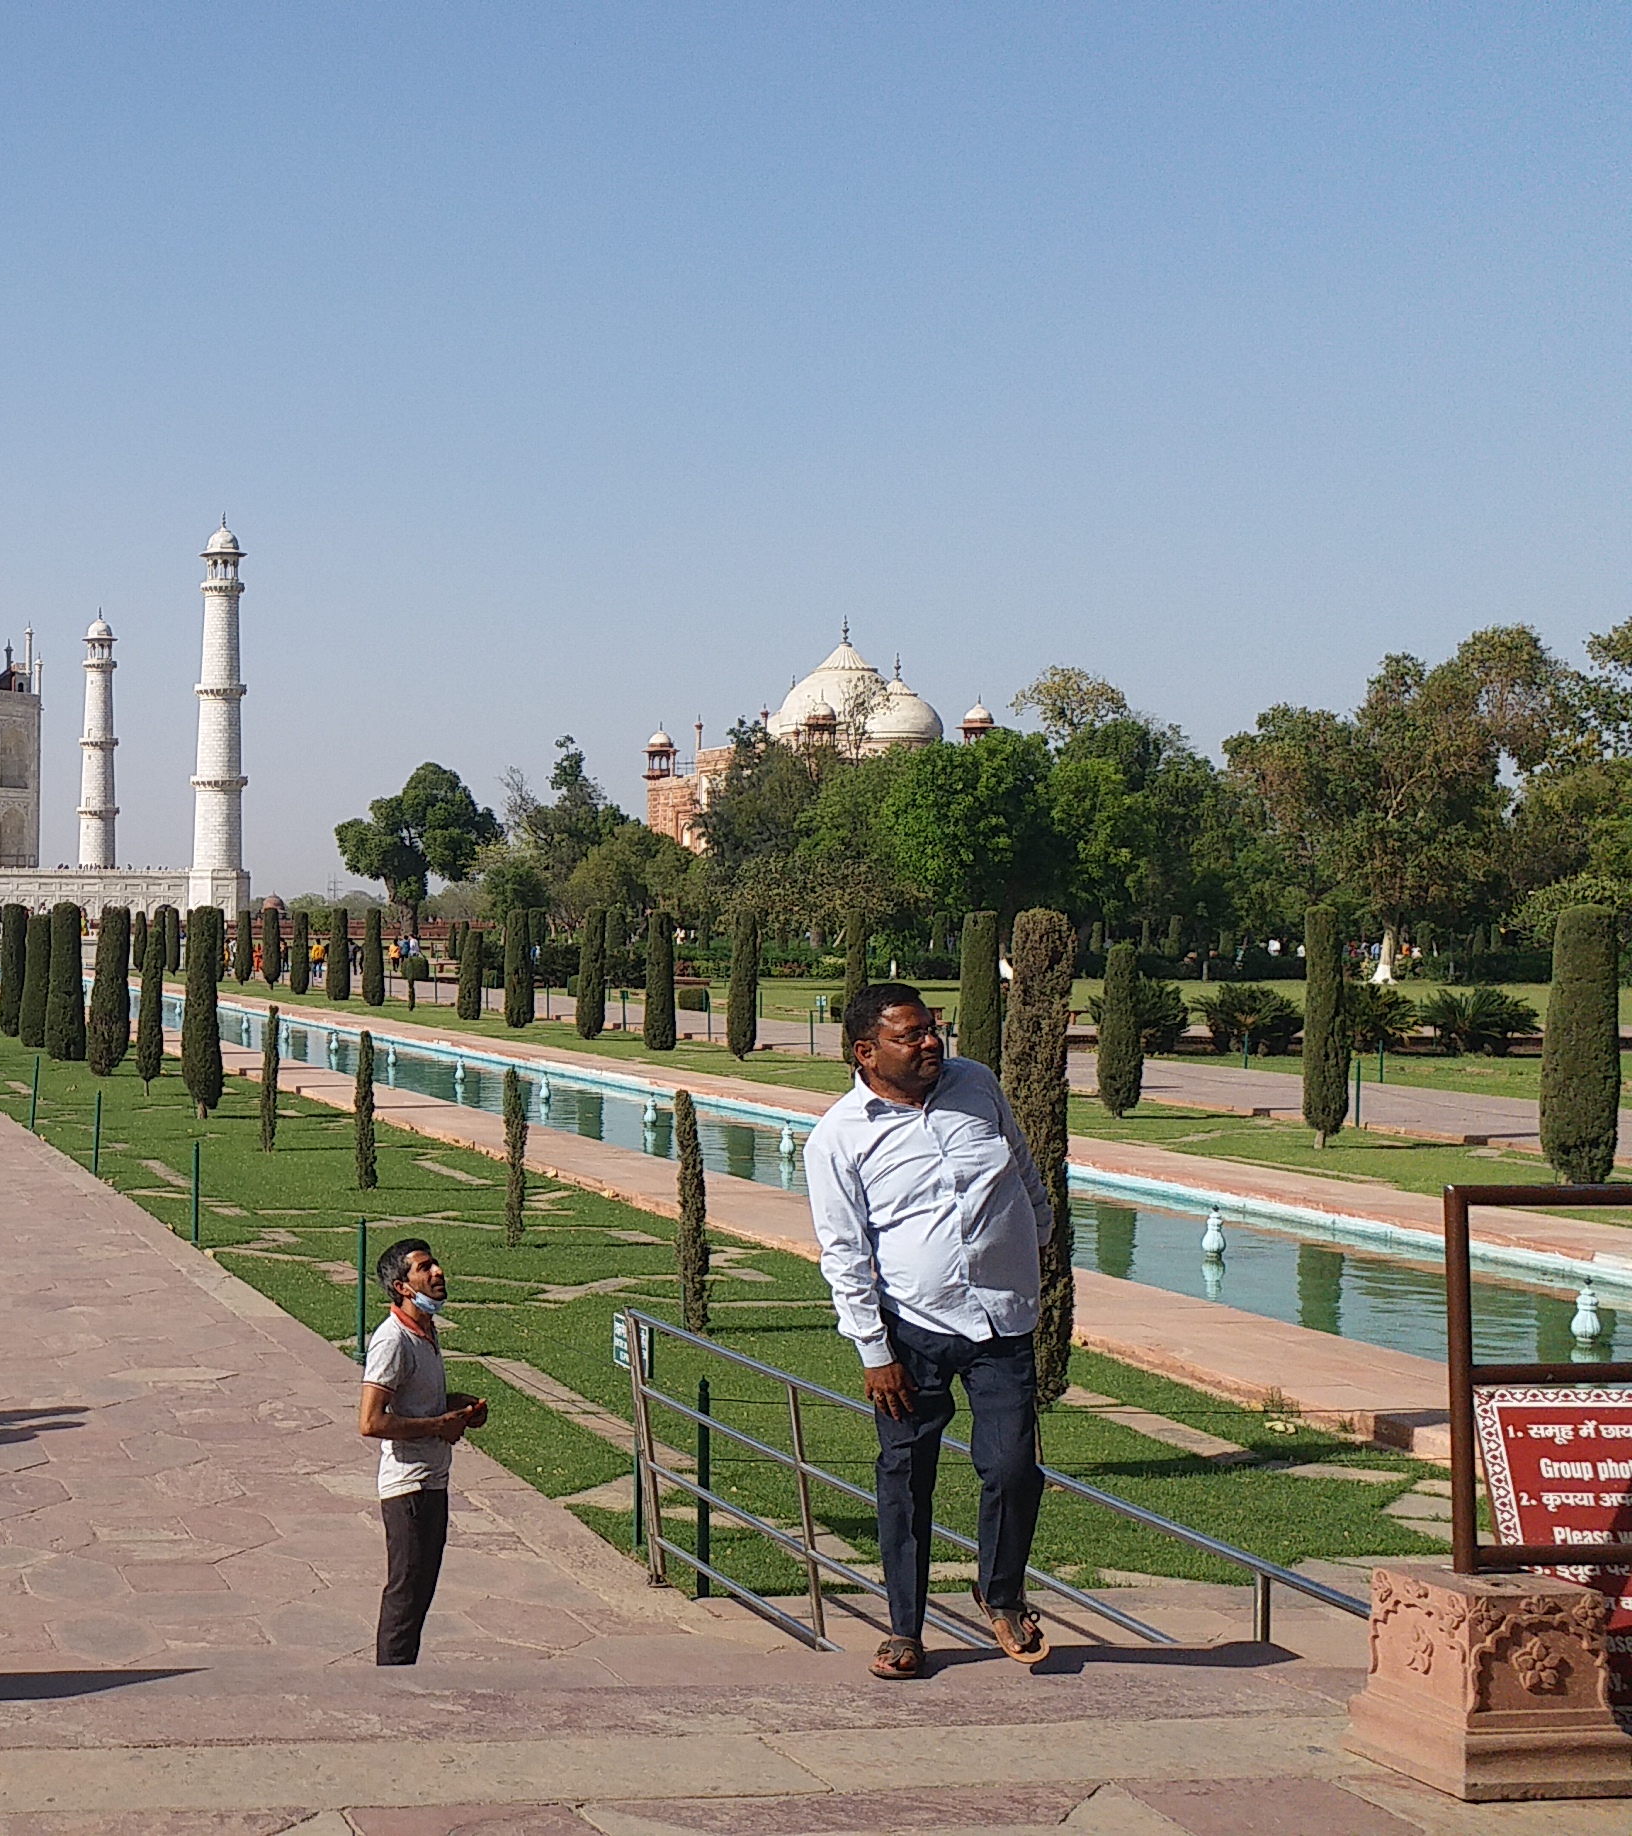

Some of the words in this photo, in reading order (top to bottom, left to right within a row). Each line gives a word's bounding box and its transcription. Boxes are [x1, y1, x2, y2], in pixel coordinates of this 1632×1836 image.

[1506, 1424, 1524, 1438] 1.
[1526, 1424, 1575, 1445] समूह
[1577, 1419, 1599, 1438] में
[1539, 1457, 1595, 1482] Group
[1518, 1492, 1538, 1506] 2.
[1540, 1492, 1596, 1512] कृपया
[1552, 1526, 1615, 1545] Please
